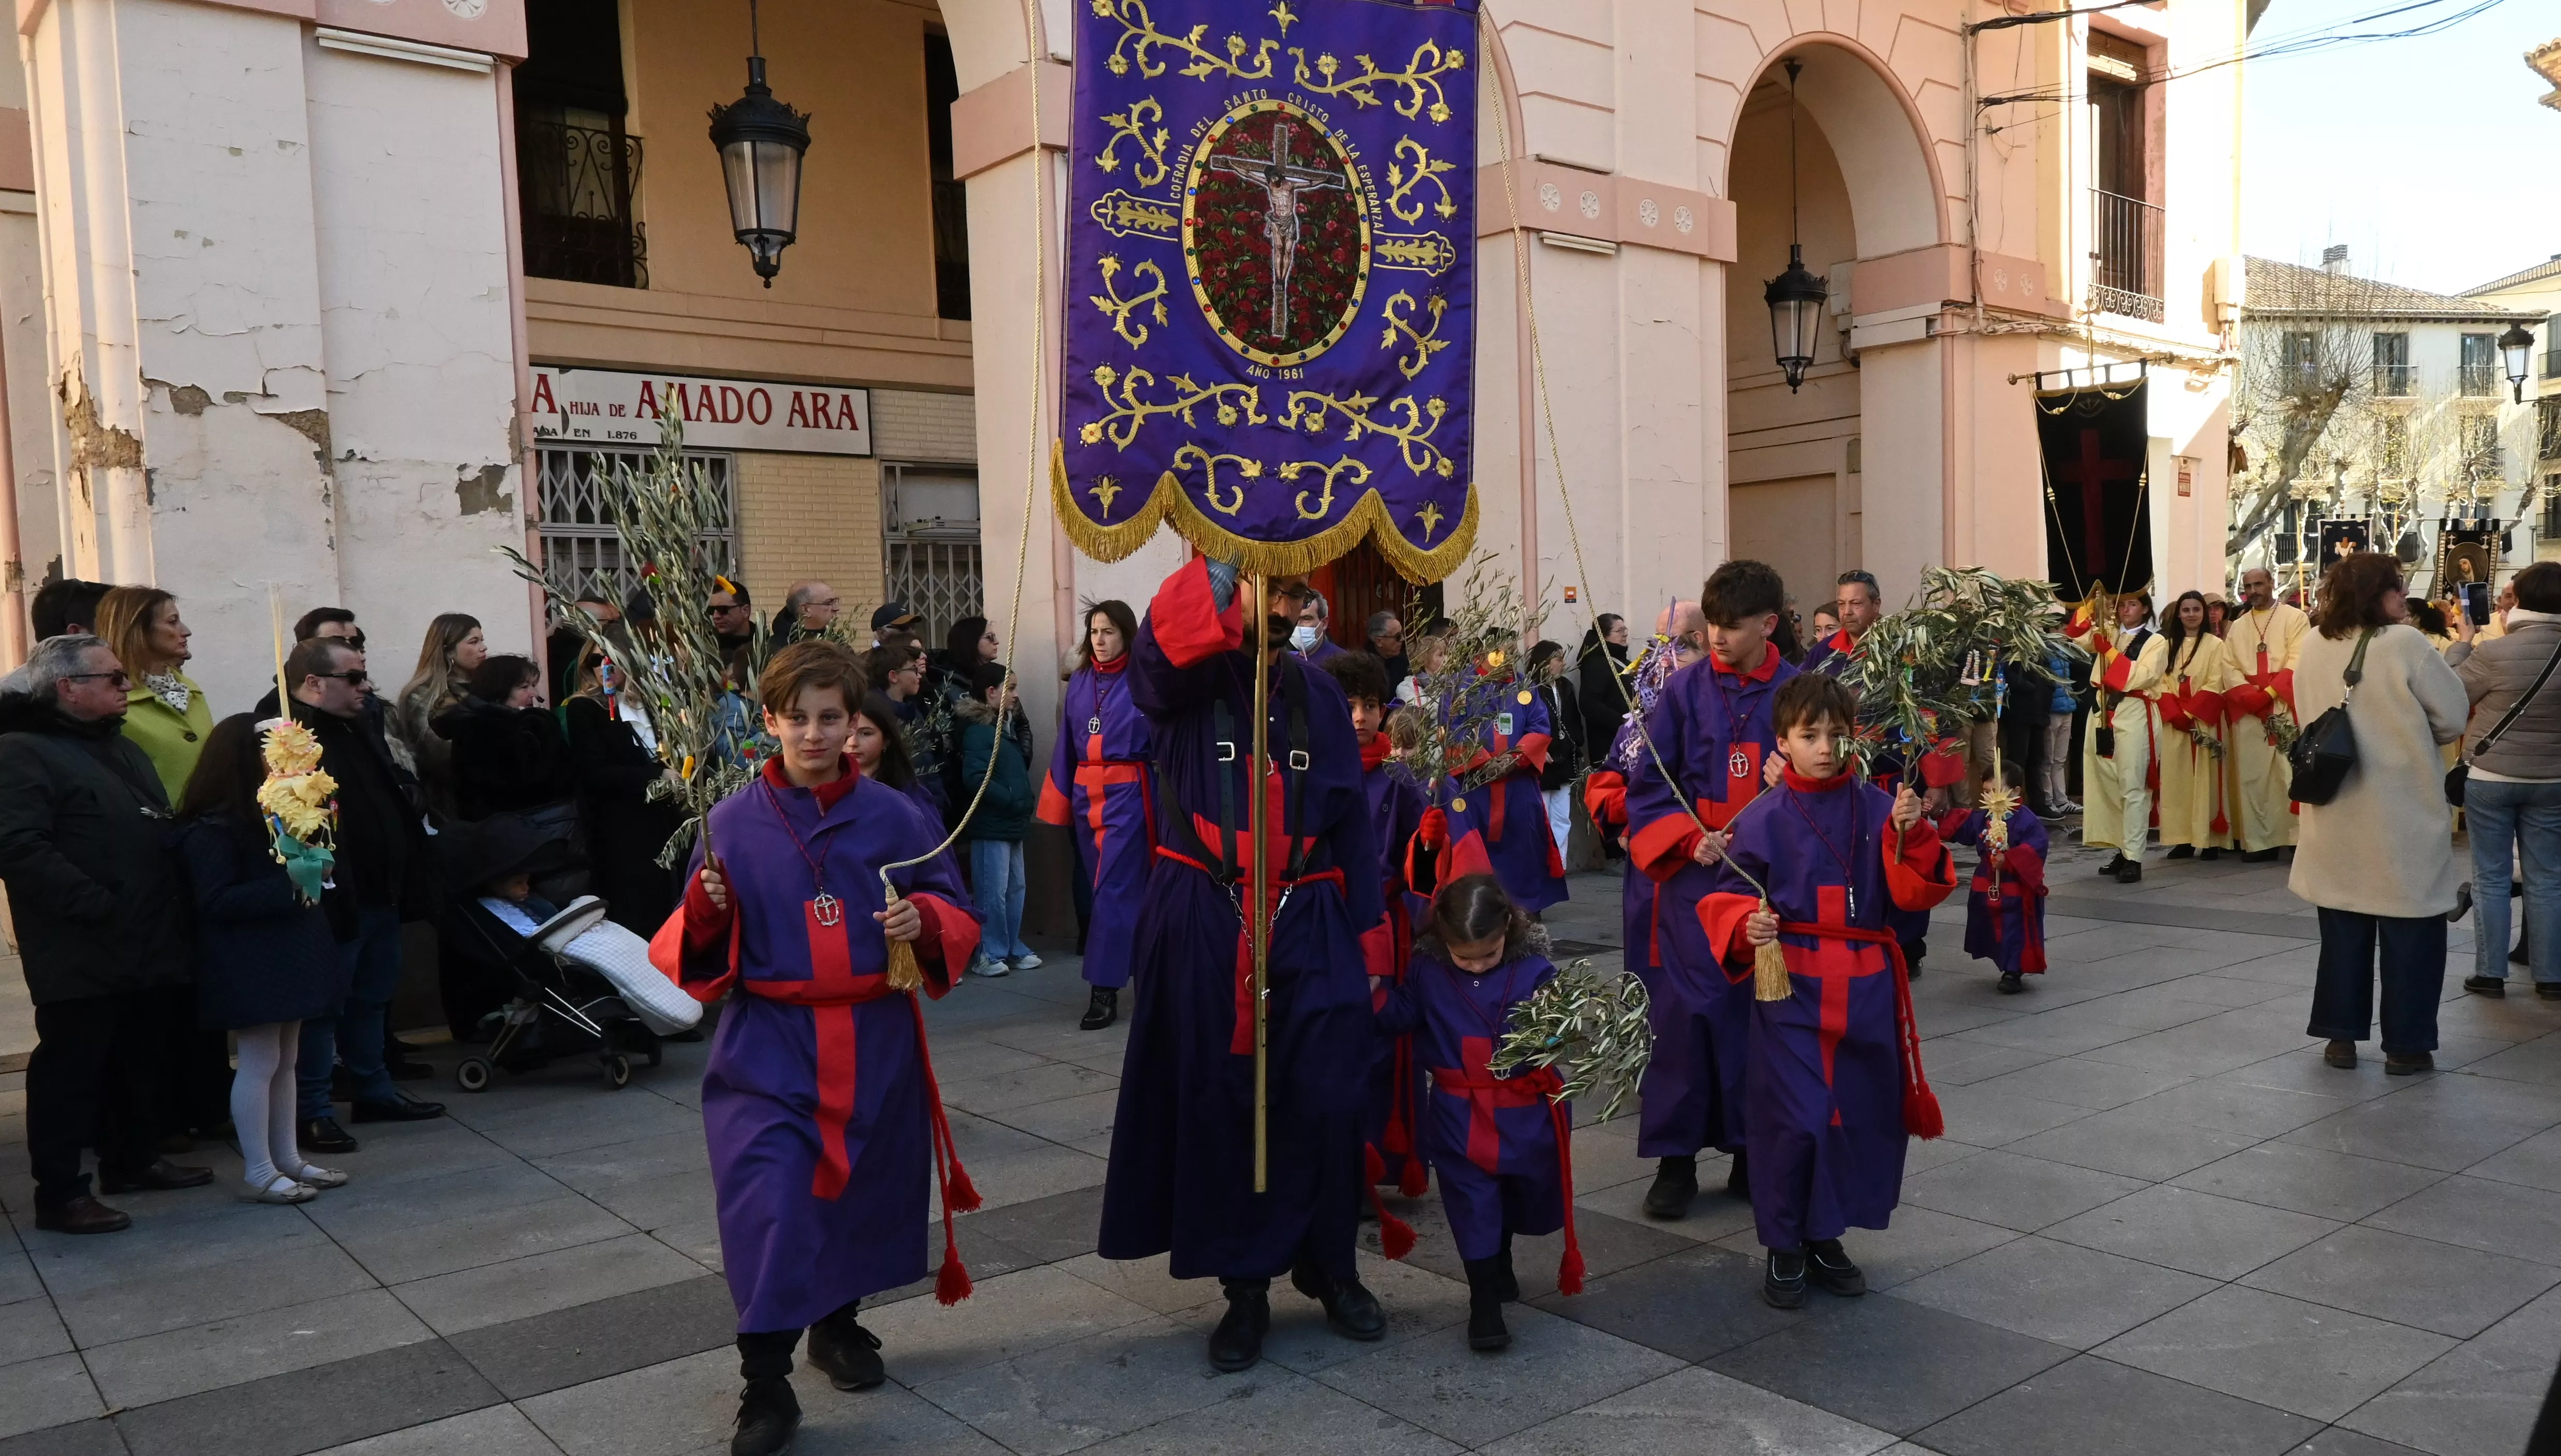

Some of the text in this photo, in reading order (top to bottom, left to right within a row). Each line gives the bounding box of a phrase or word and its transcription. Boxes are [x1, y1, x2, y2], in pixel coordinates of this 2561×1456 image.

[1170, 89, 1384, 229] COFRADIA DEL SANTO CRISTO DE LA ESPERANZA
[1246, 364, 1304, 380] AÑO 1961
[569, 401, 600, 416] HIJA
[609, 403, 626, 418] DE
[634, 380, 772, 425] AMADO
[786, 391, 859, 431] ARA
[573, 428, 591, 438] EN
[607, 430, 638, 440] 1.876
